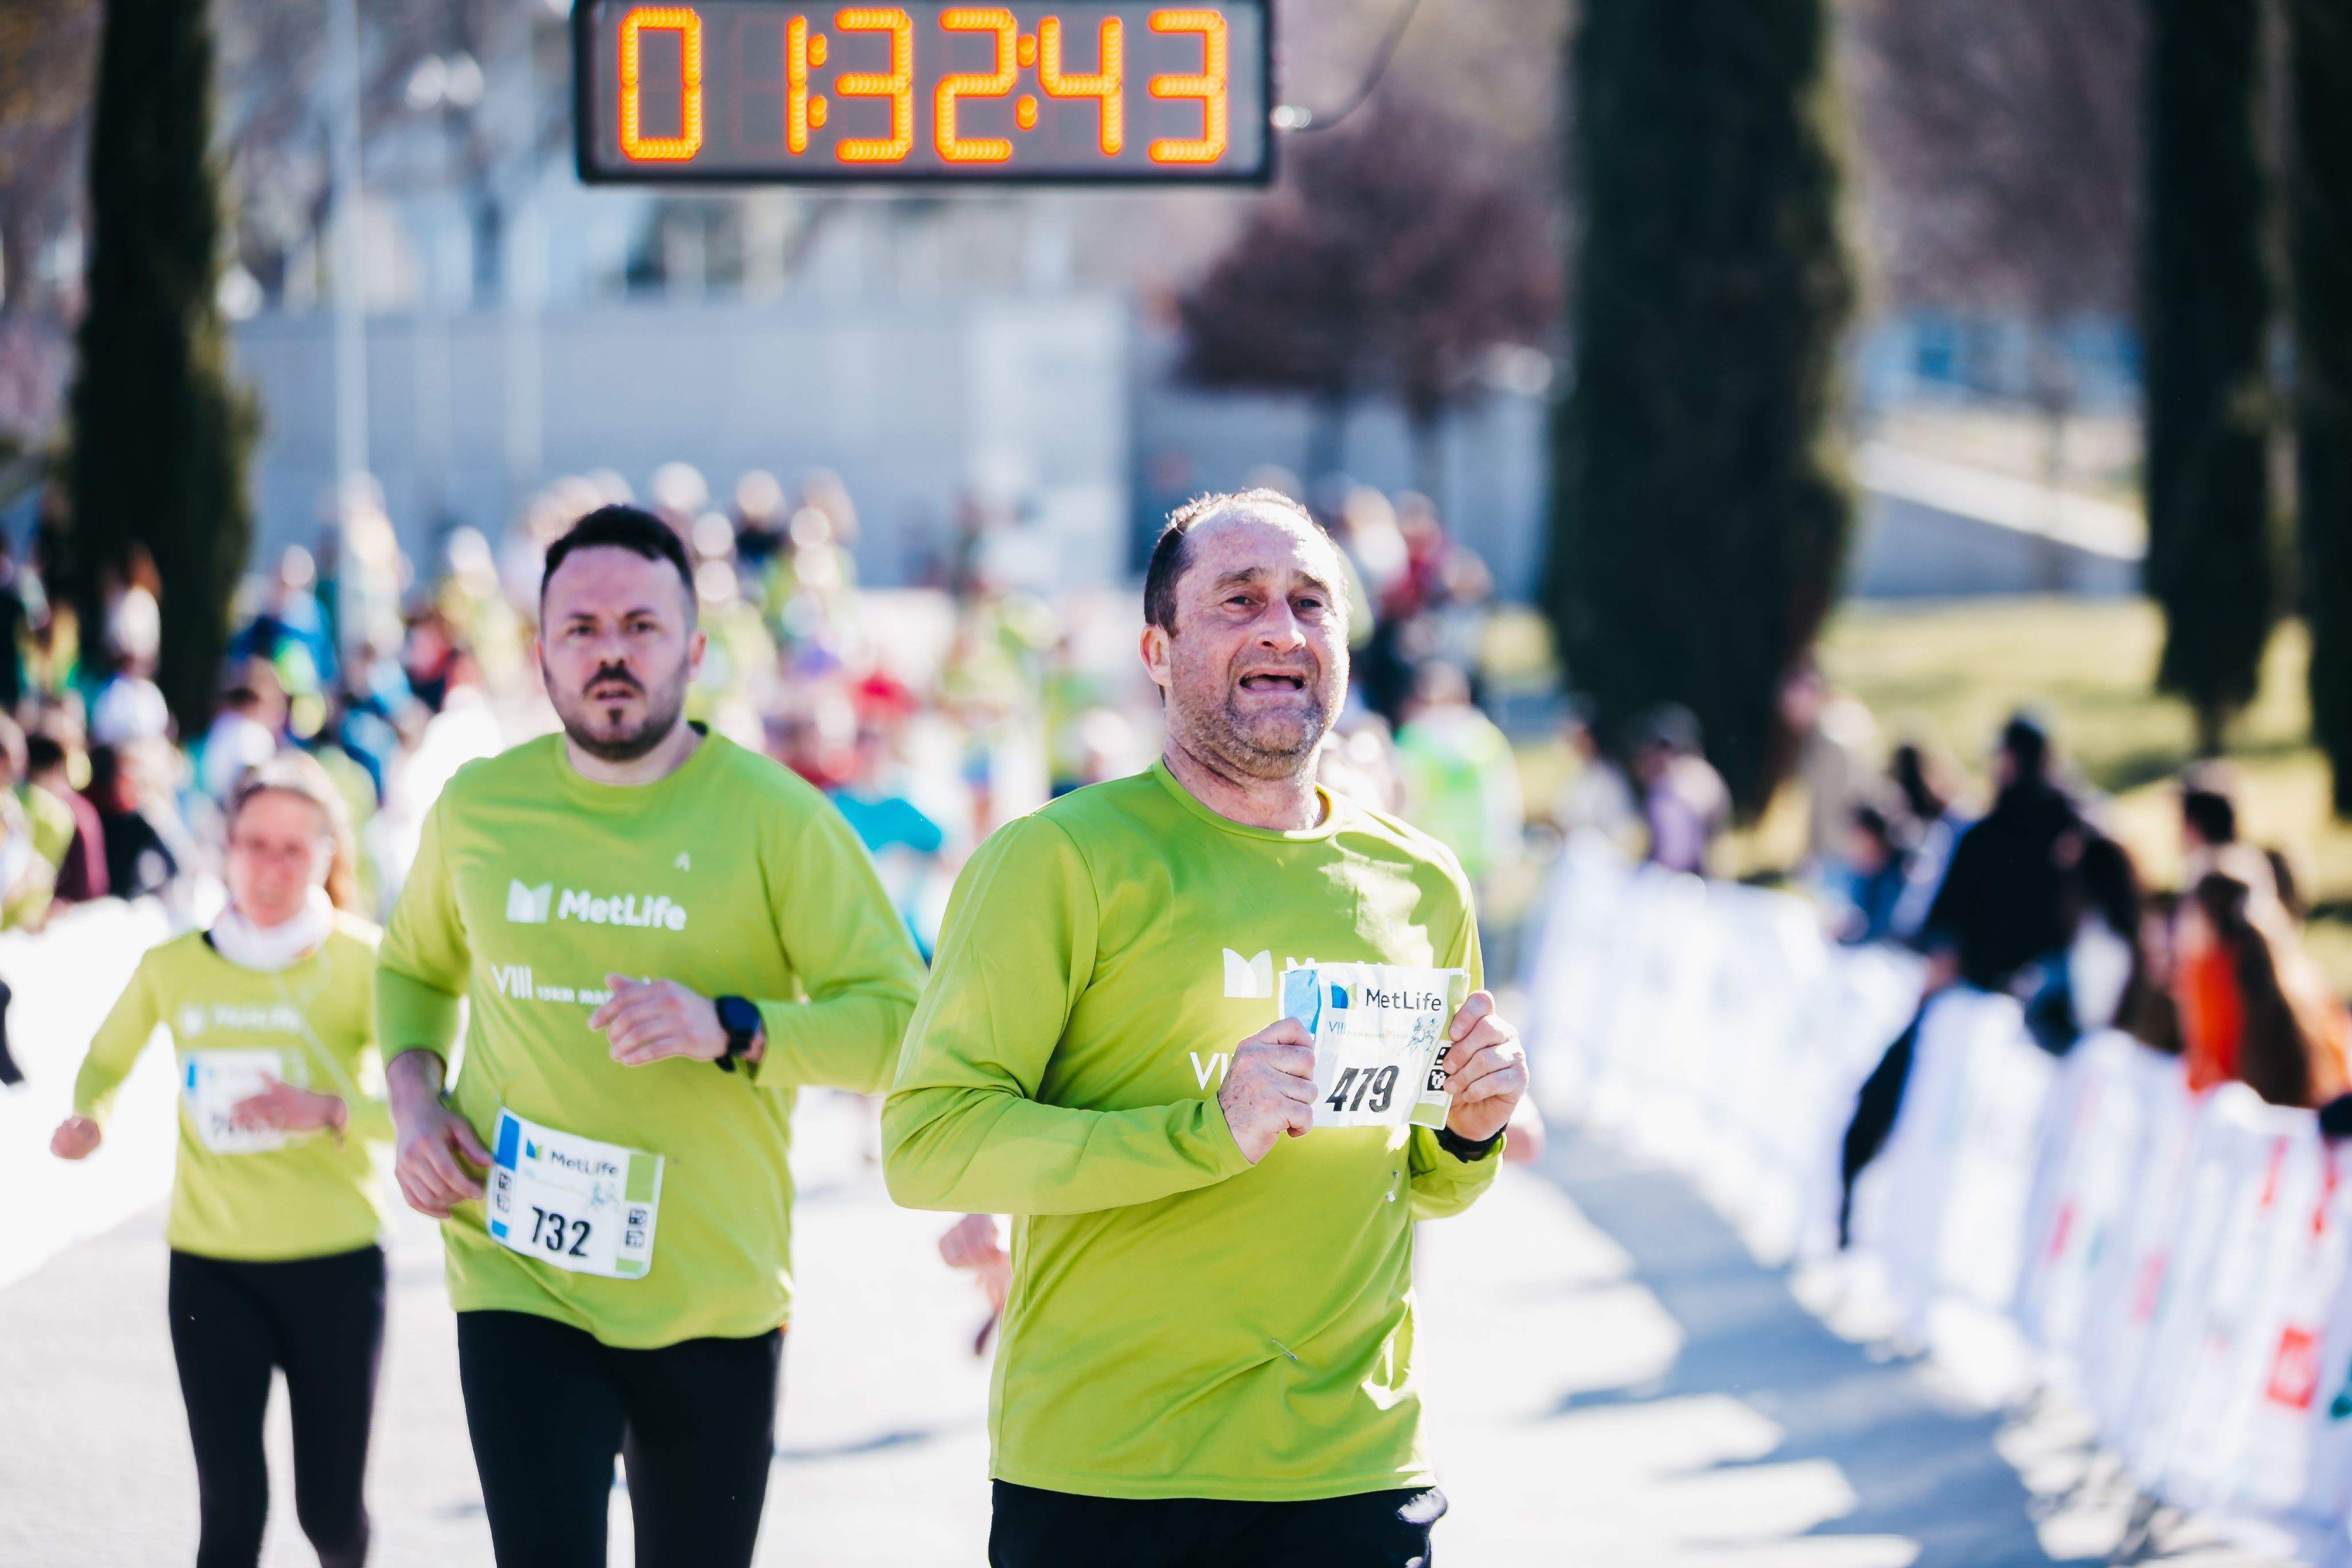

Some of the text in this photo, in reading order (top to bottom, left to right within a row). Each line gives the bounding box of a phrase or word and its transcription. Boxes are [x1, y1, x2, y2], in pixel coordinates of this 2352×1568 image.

[558, 888, 687, 930] MetLife
[491, 963, 532, 999] VIII
[1366, 988, 1441, 1011] MetLife
[1326, 1065, 1400, 1113] 479
[551, 1150, 620, 1175] MetLife
[532, 1206, 591, 1257] 732
